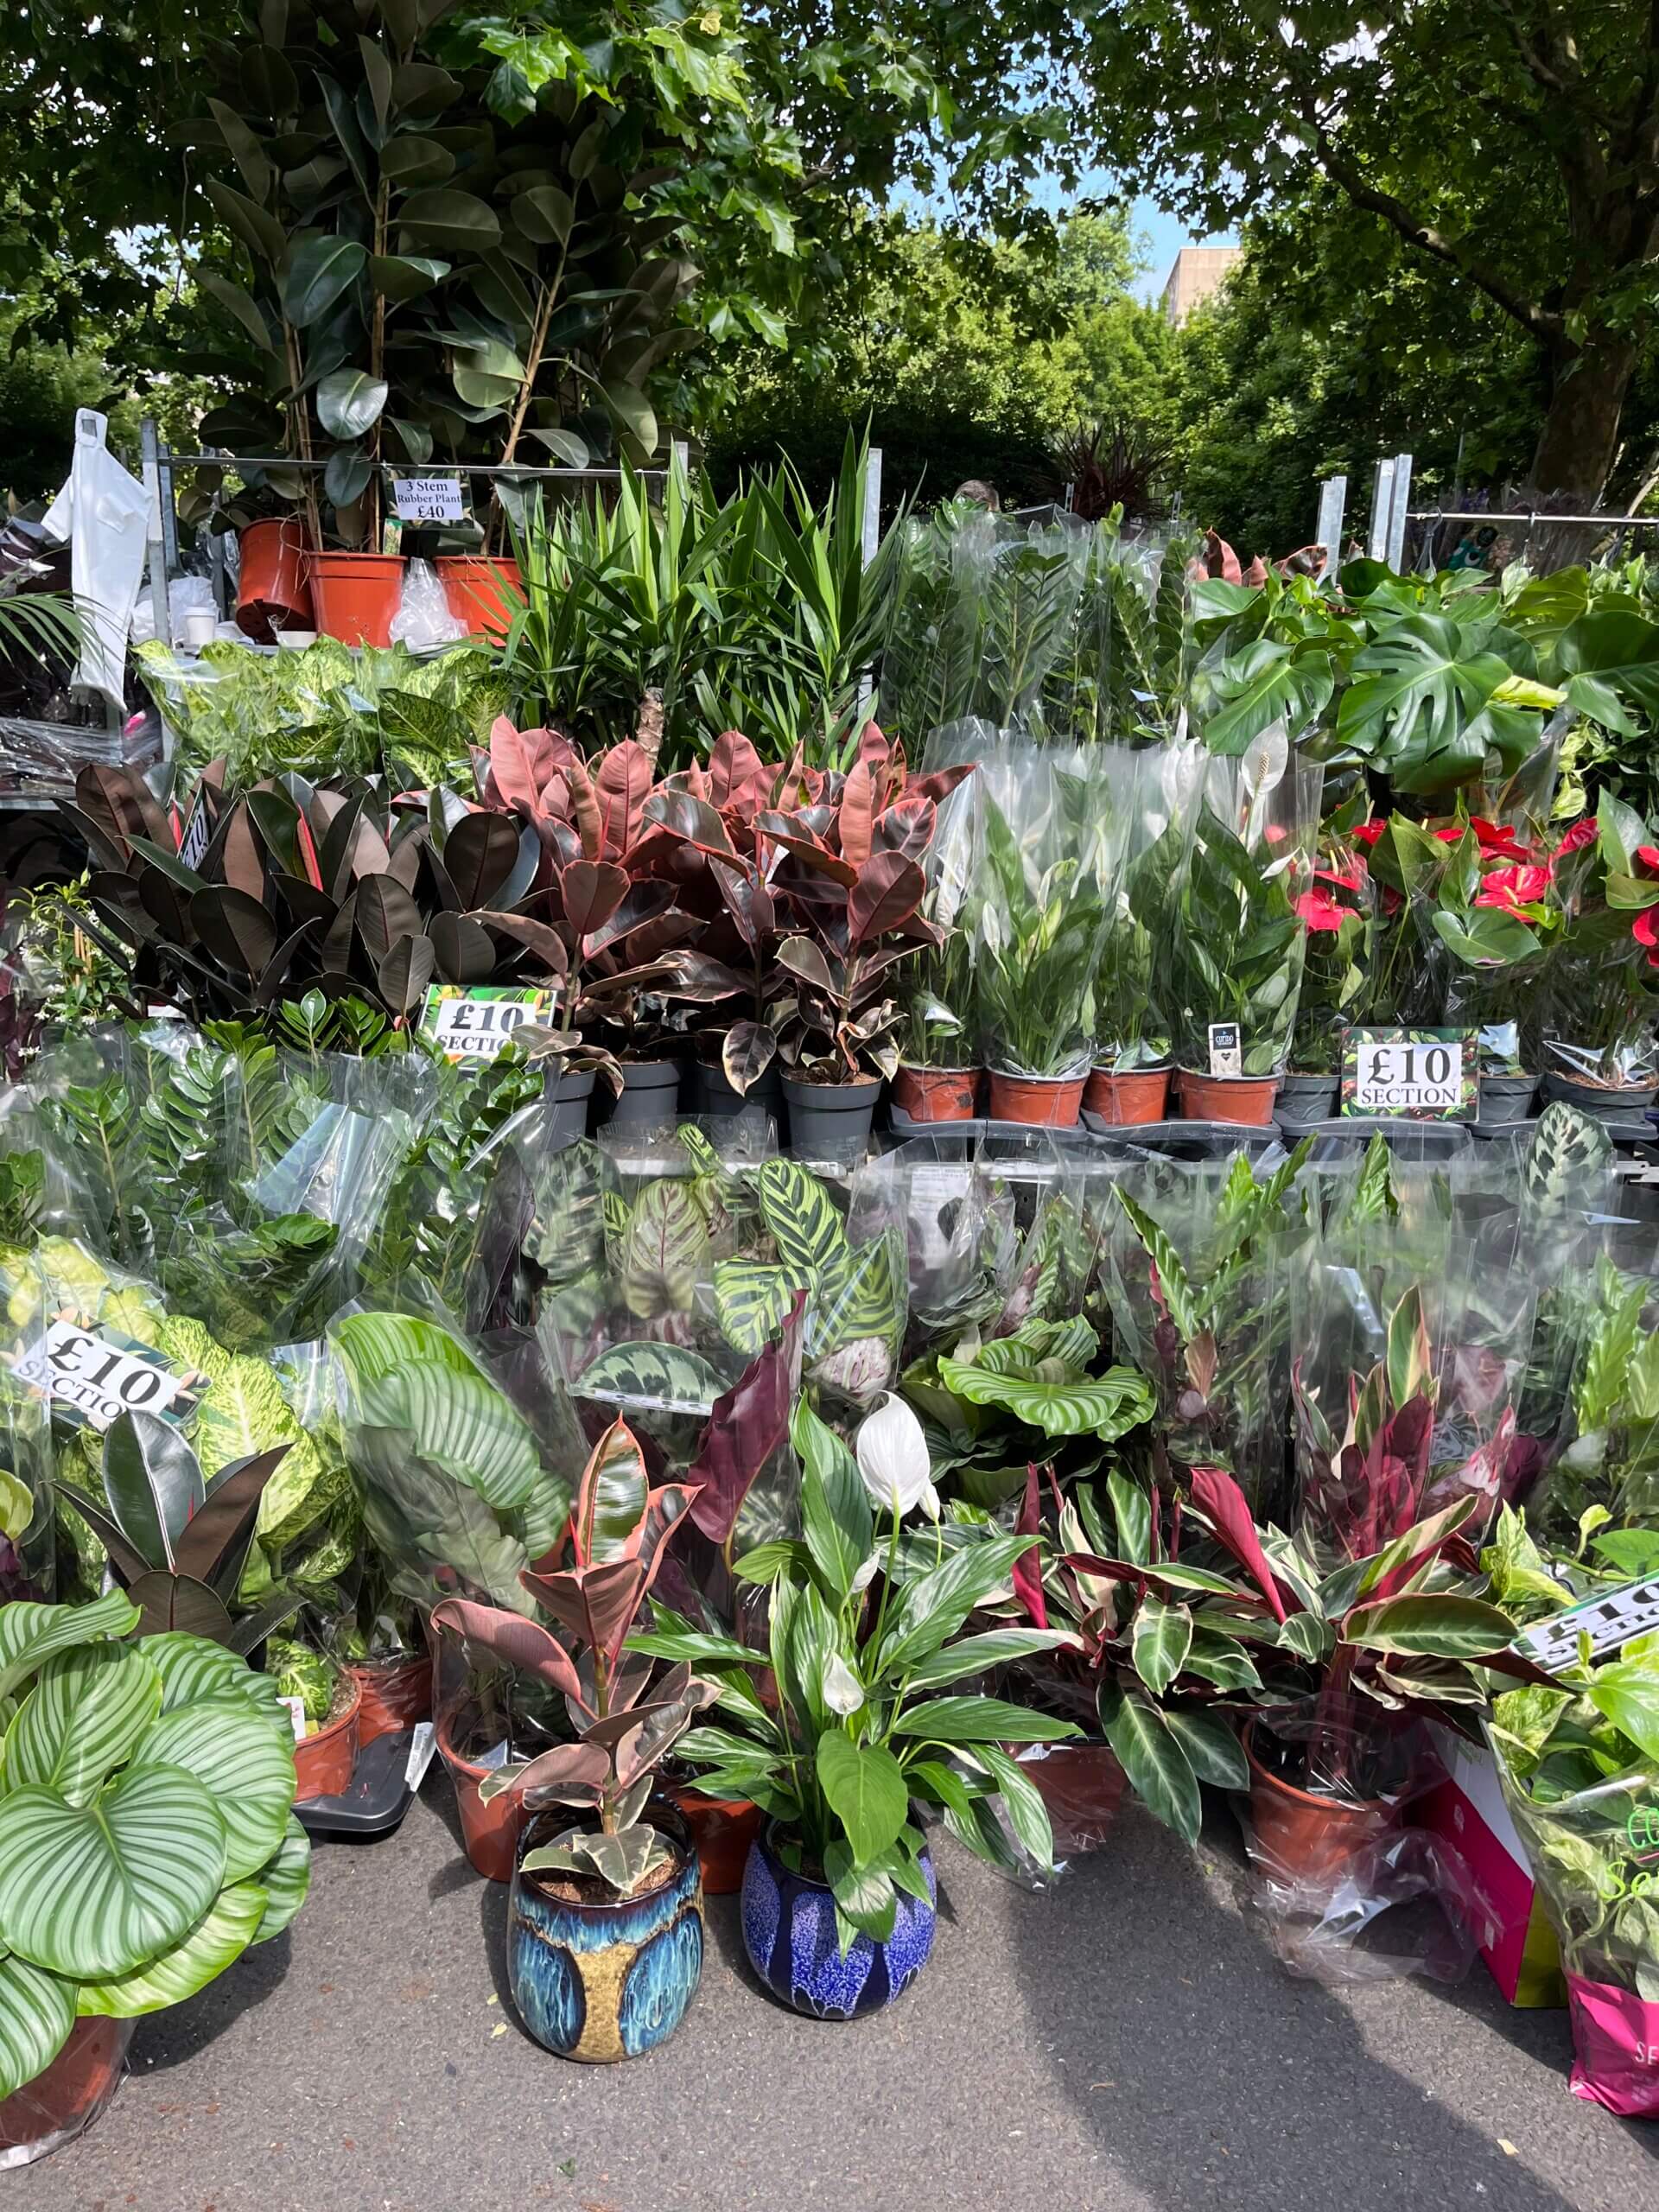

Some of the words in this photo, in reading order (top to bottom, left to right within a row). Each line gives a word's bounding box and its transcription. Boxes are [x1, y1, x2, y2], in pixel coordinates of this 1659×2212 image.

[406, 480, 414, 492] 3
[416, 480, 448, 492] Stem
[397, 494, 433, 503] Rubber
[435, 494, 461, 503] Plant
[417, 505, 445, 518] £40
[449, 1004, 524, 1033] £10
[435, 1034, 512, 1052] SECTI
[1367, 1048, 1451, 1084] £10
[1361, 1088, 1459, 1104] SECTION
[48, 1337, 161, 1404] £10
[18, 1360, 123, 1418] SECTIO
